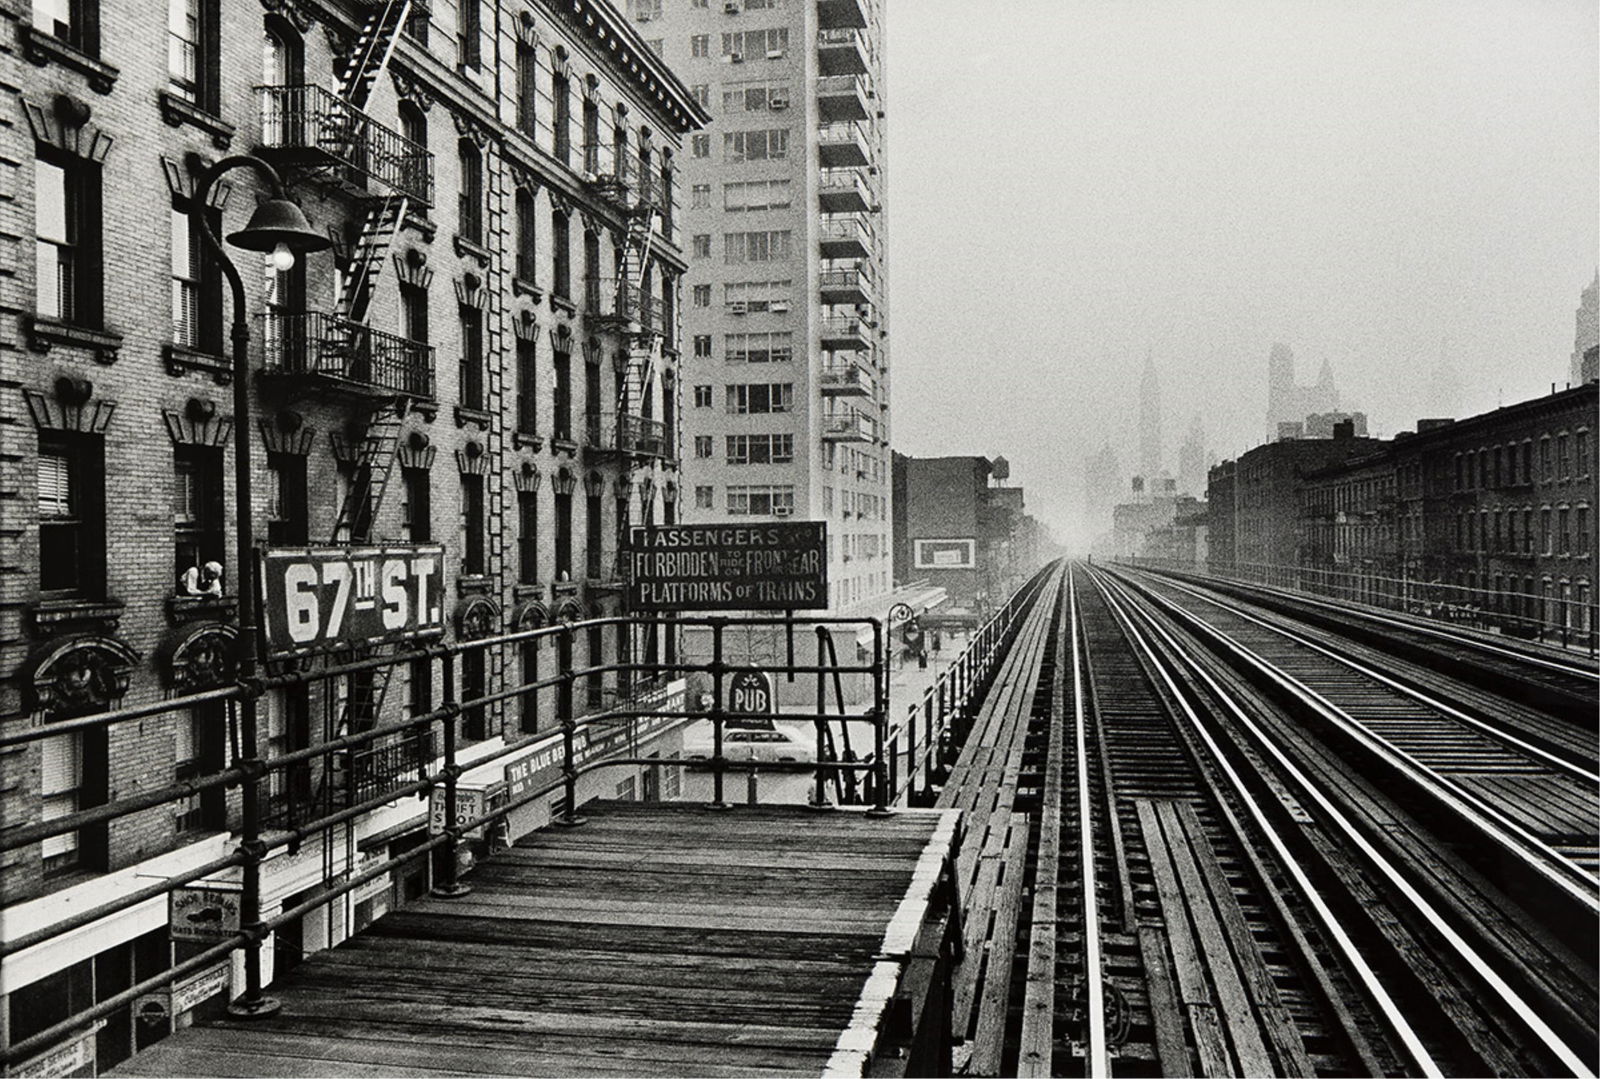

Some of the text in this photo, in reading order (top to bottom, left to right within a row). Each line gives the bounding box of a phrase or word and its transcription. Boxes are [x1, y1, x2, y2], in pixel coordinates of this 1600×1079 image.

[636, 551, 719, 577] FORBIDDEN
[745, 549, 787, 576] FRON
[382, 559, 440, 631] ST.
[640, 580, 733, 603] PLATFORMS
[756, 580, 817, 601] TRAINS
[735, 688, 767, 712] PUB
[510, 762, 529, 783] THE
[530, 751, 551, 773] BLUE
[434, 801, 476, 814] THIFT
[434, 812, 476, 825] SOP
